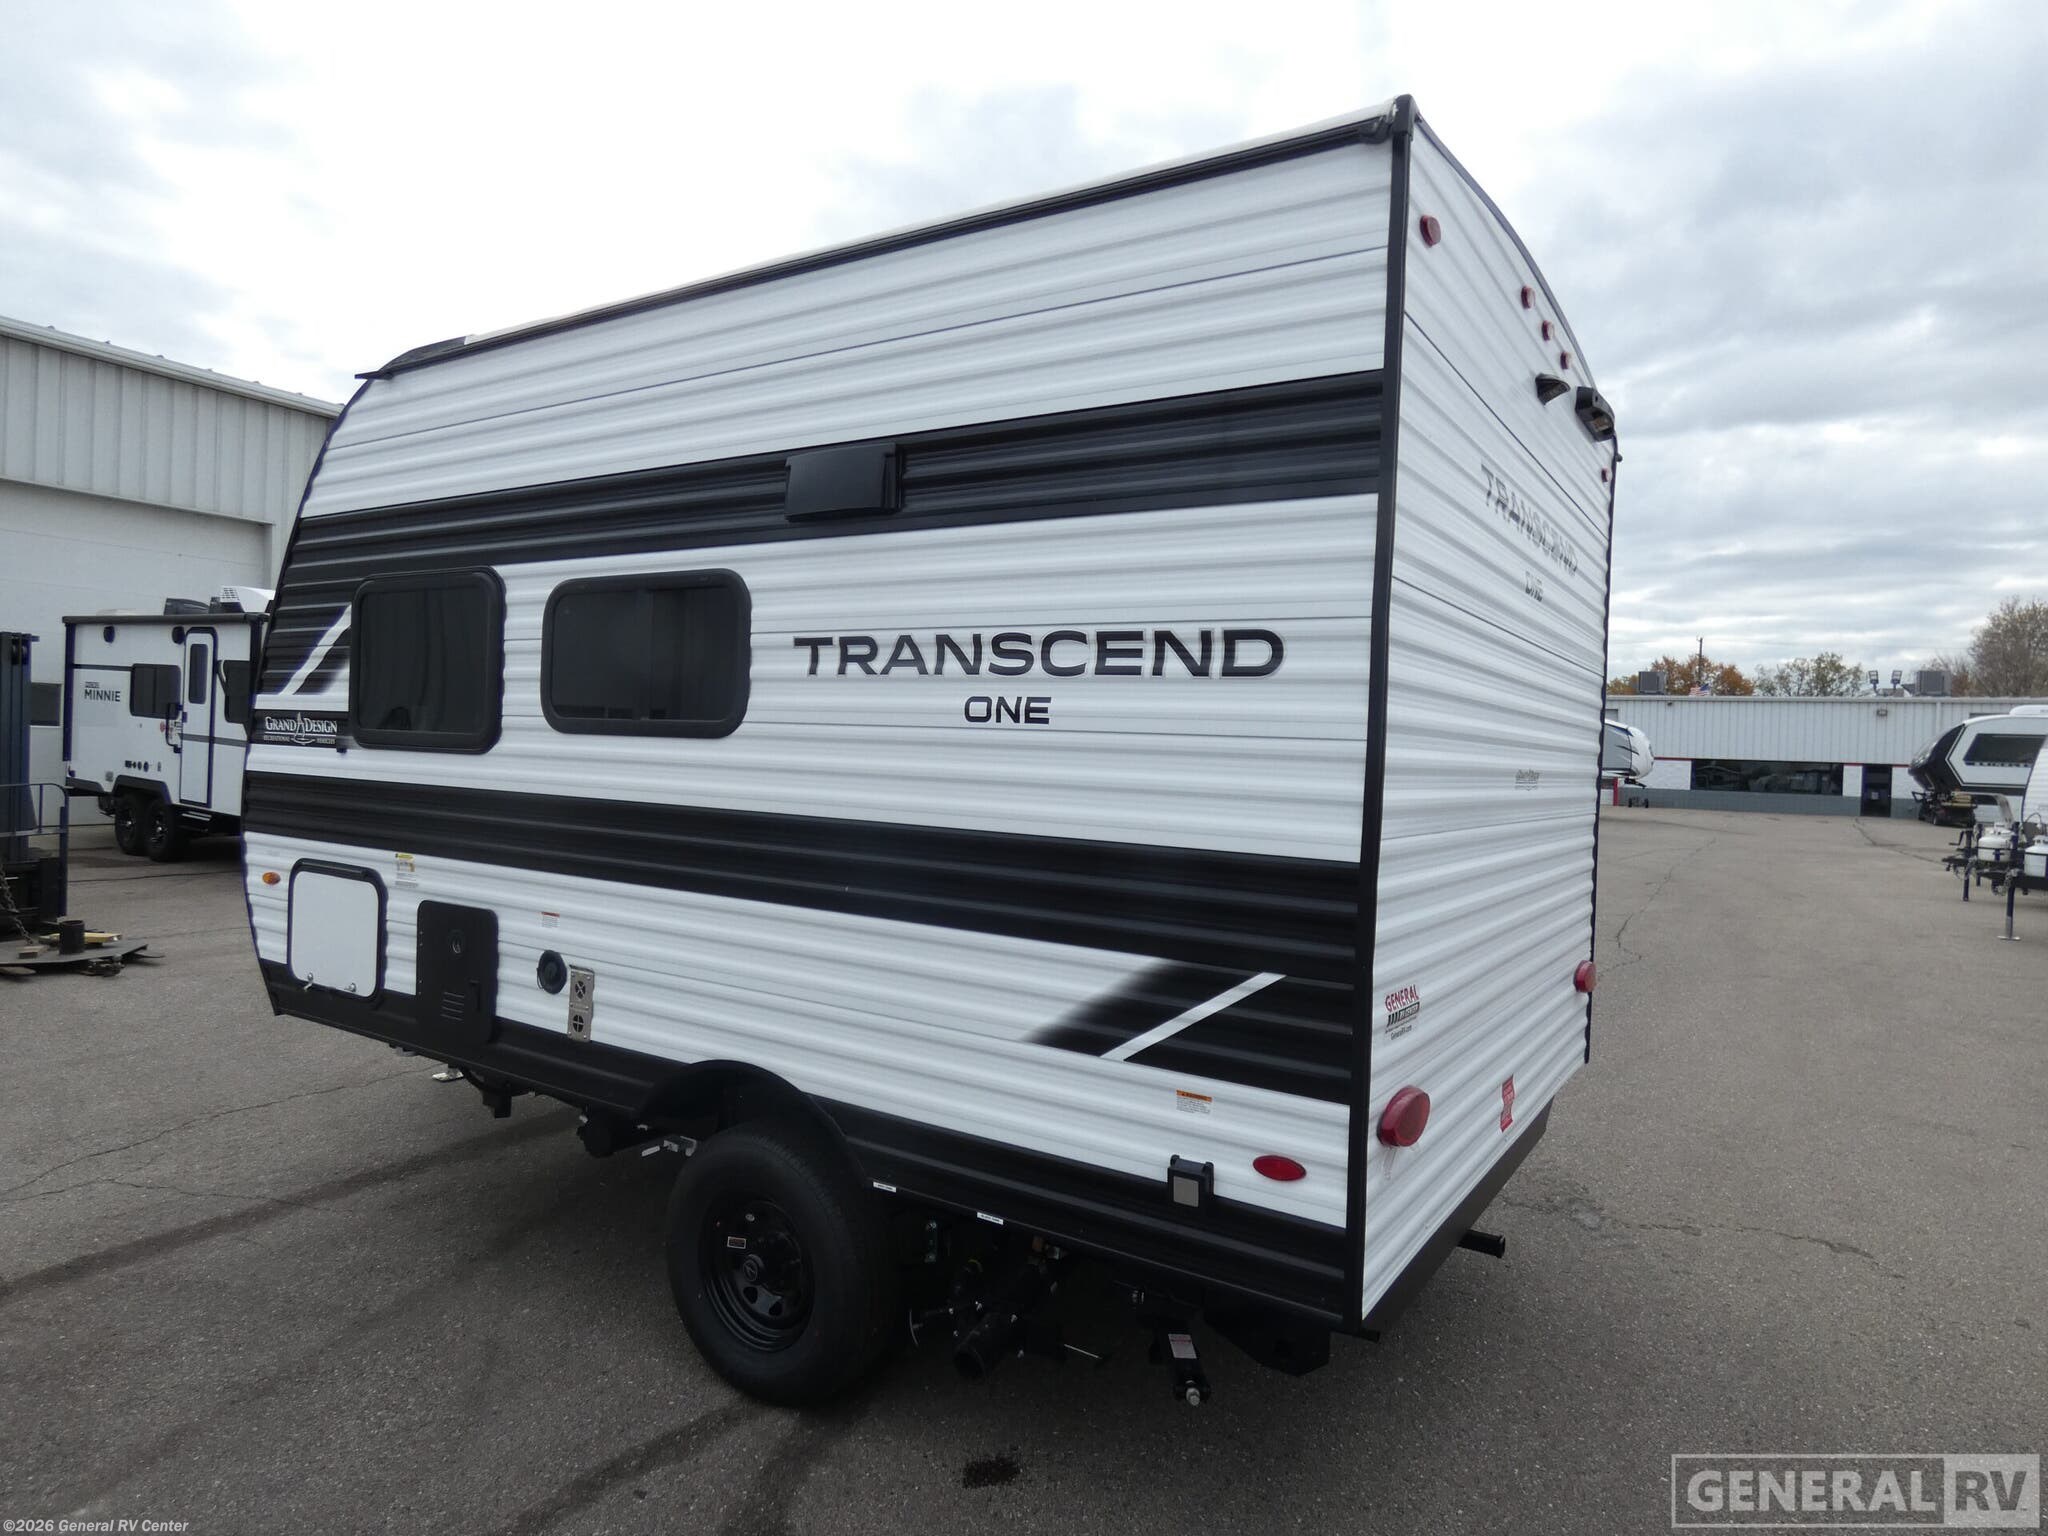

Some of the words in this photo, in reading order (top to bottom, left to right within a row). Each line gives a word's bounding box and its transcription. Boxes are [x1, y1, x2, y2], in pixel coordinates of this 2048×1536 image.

[793, 628, 1286, 679] TRANSCEND
[84, 689, 121, 702] MINNIE
[265, 716, 297, 731] GRAND
[303, 717, 338, 733] DESIGN
[964, 696, 1052, 725] ONE
[1385, 984, 1419, 1012] GENERAL
